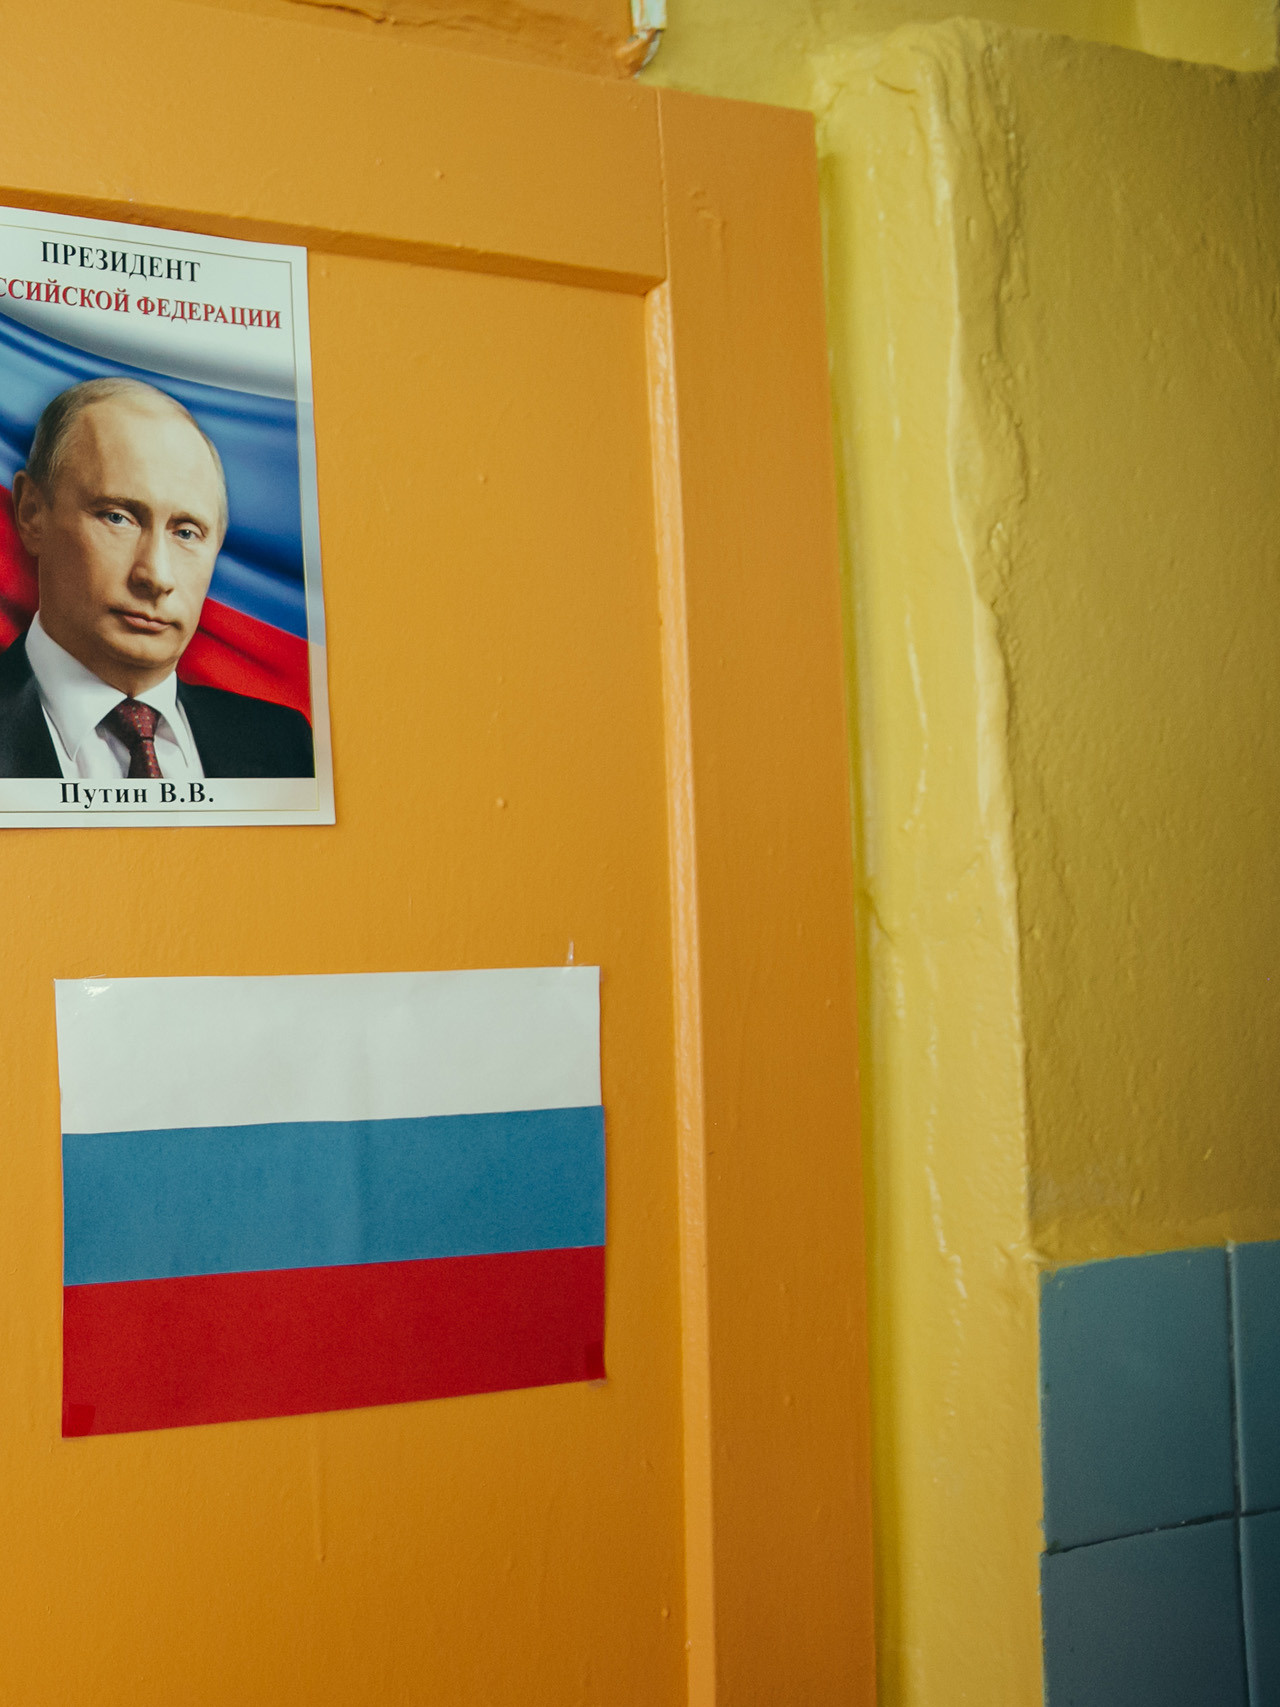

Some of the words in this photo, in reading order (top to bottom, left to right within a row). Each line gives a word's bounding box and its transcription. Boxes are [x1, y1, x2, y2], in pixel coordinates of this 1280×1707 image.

[41, 241, 200, 282] ПРЕЗИДЕНТ
[137, 295, 282, 329] ФЕДЕРАЦИИ
[60, 782, 147, 809] Путин
[160, 782, 214, 803] В.В.
